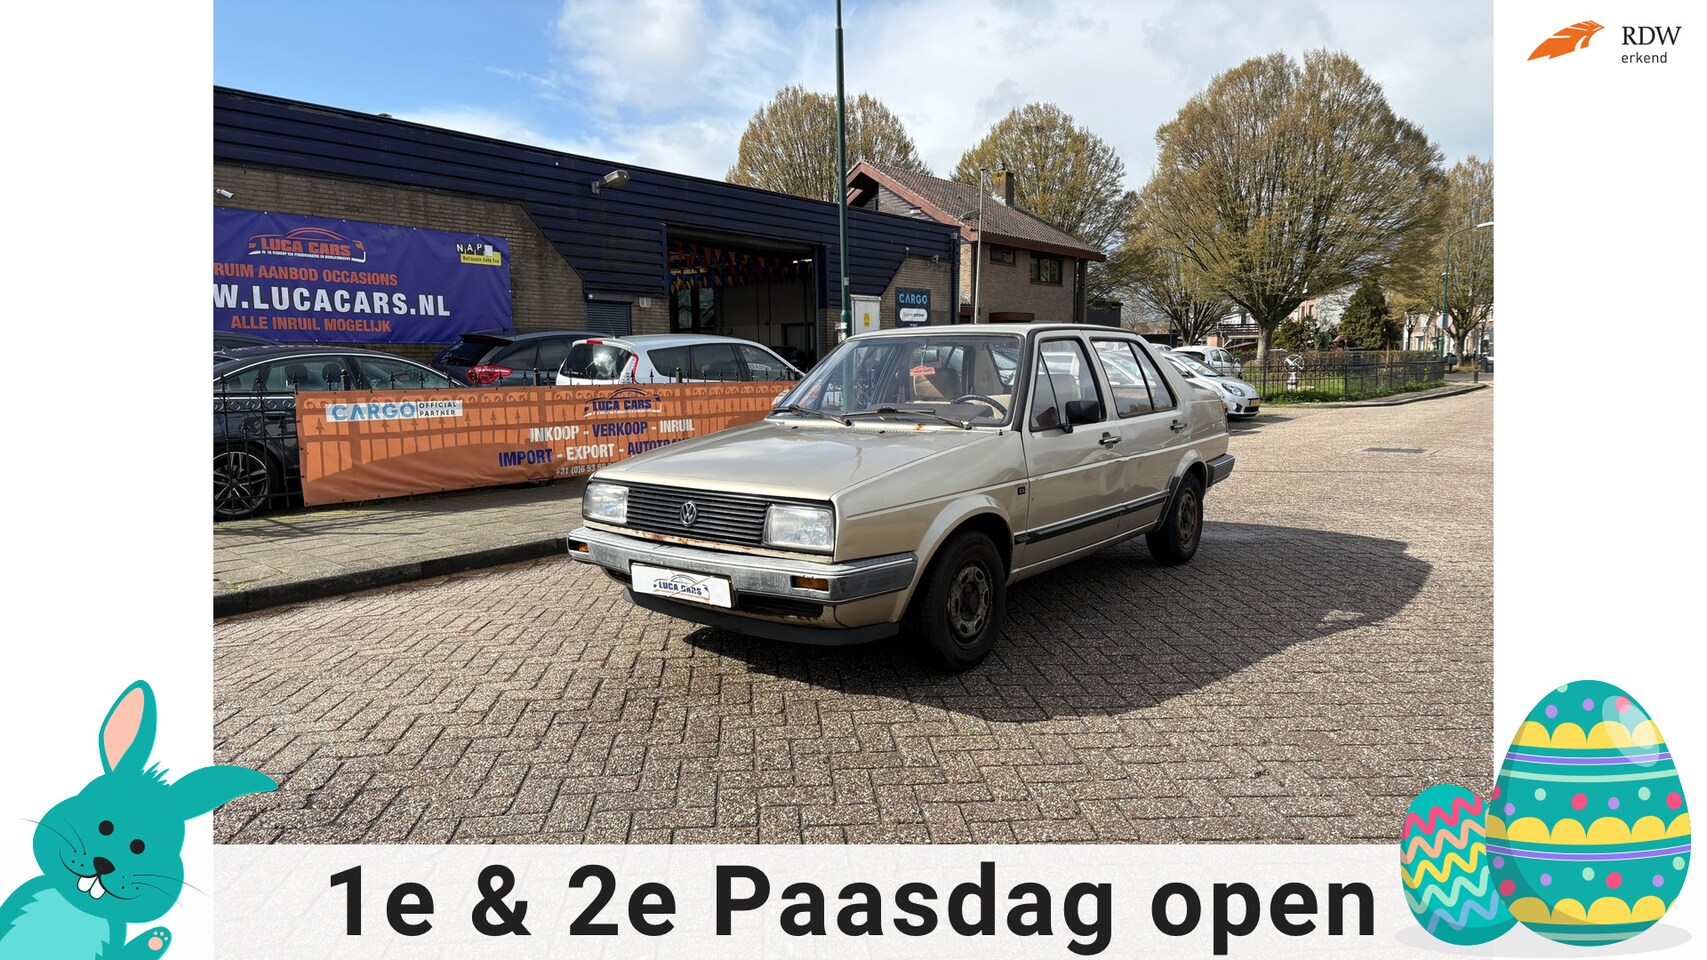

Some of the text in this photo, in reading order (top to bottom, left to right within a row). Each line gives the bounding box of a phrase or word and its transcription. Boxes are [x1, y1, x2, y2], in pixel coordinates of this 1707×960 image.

[261, 238, 304, 252] LUCA
[308, 241, 351, 256] CARS
[213, 263, 398, 286] RUIM AANBOD OCCASIONS
[899, 293, 928, 304] CARGO
[231, 315, 392, 332] ALLE INRUIL MOGELIJK
[332, 402, 416, 421] CARGO
[419, 401, 457, 409] OFFICIAL
[419, 409, 456, 417] PARTNER
[592, 399, 652, 411] LUCA CARS
[529, 425, 580, 442] INKOOP
[592, 421, 648, 437] VERKOOP
[659, 419, 695, 433] INRUIL
[498, 449, 553, 467] IMPORT
[566, 443, 614, 461] EXPORT
[658, 581, 679, 591] LUCA
